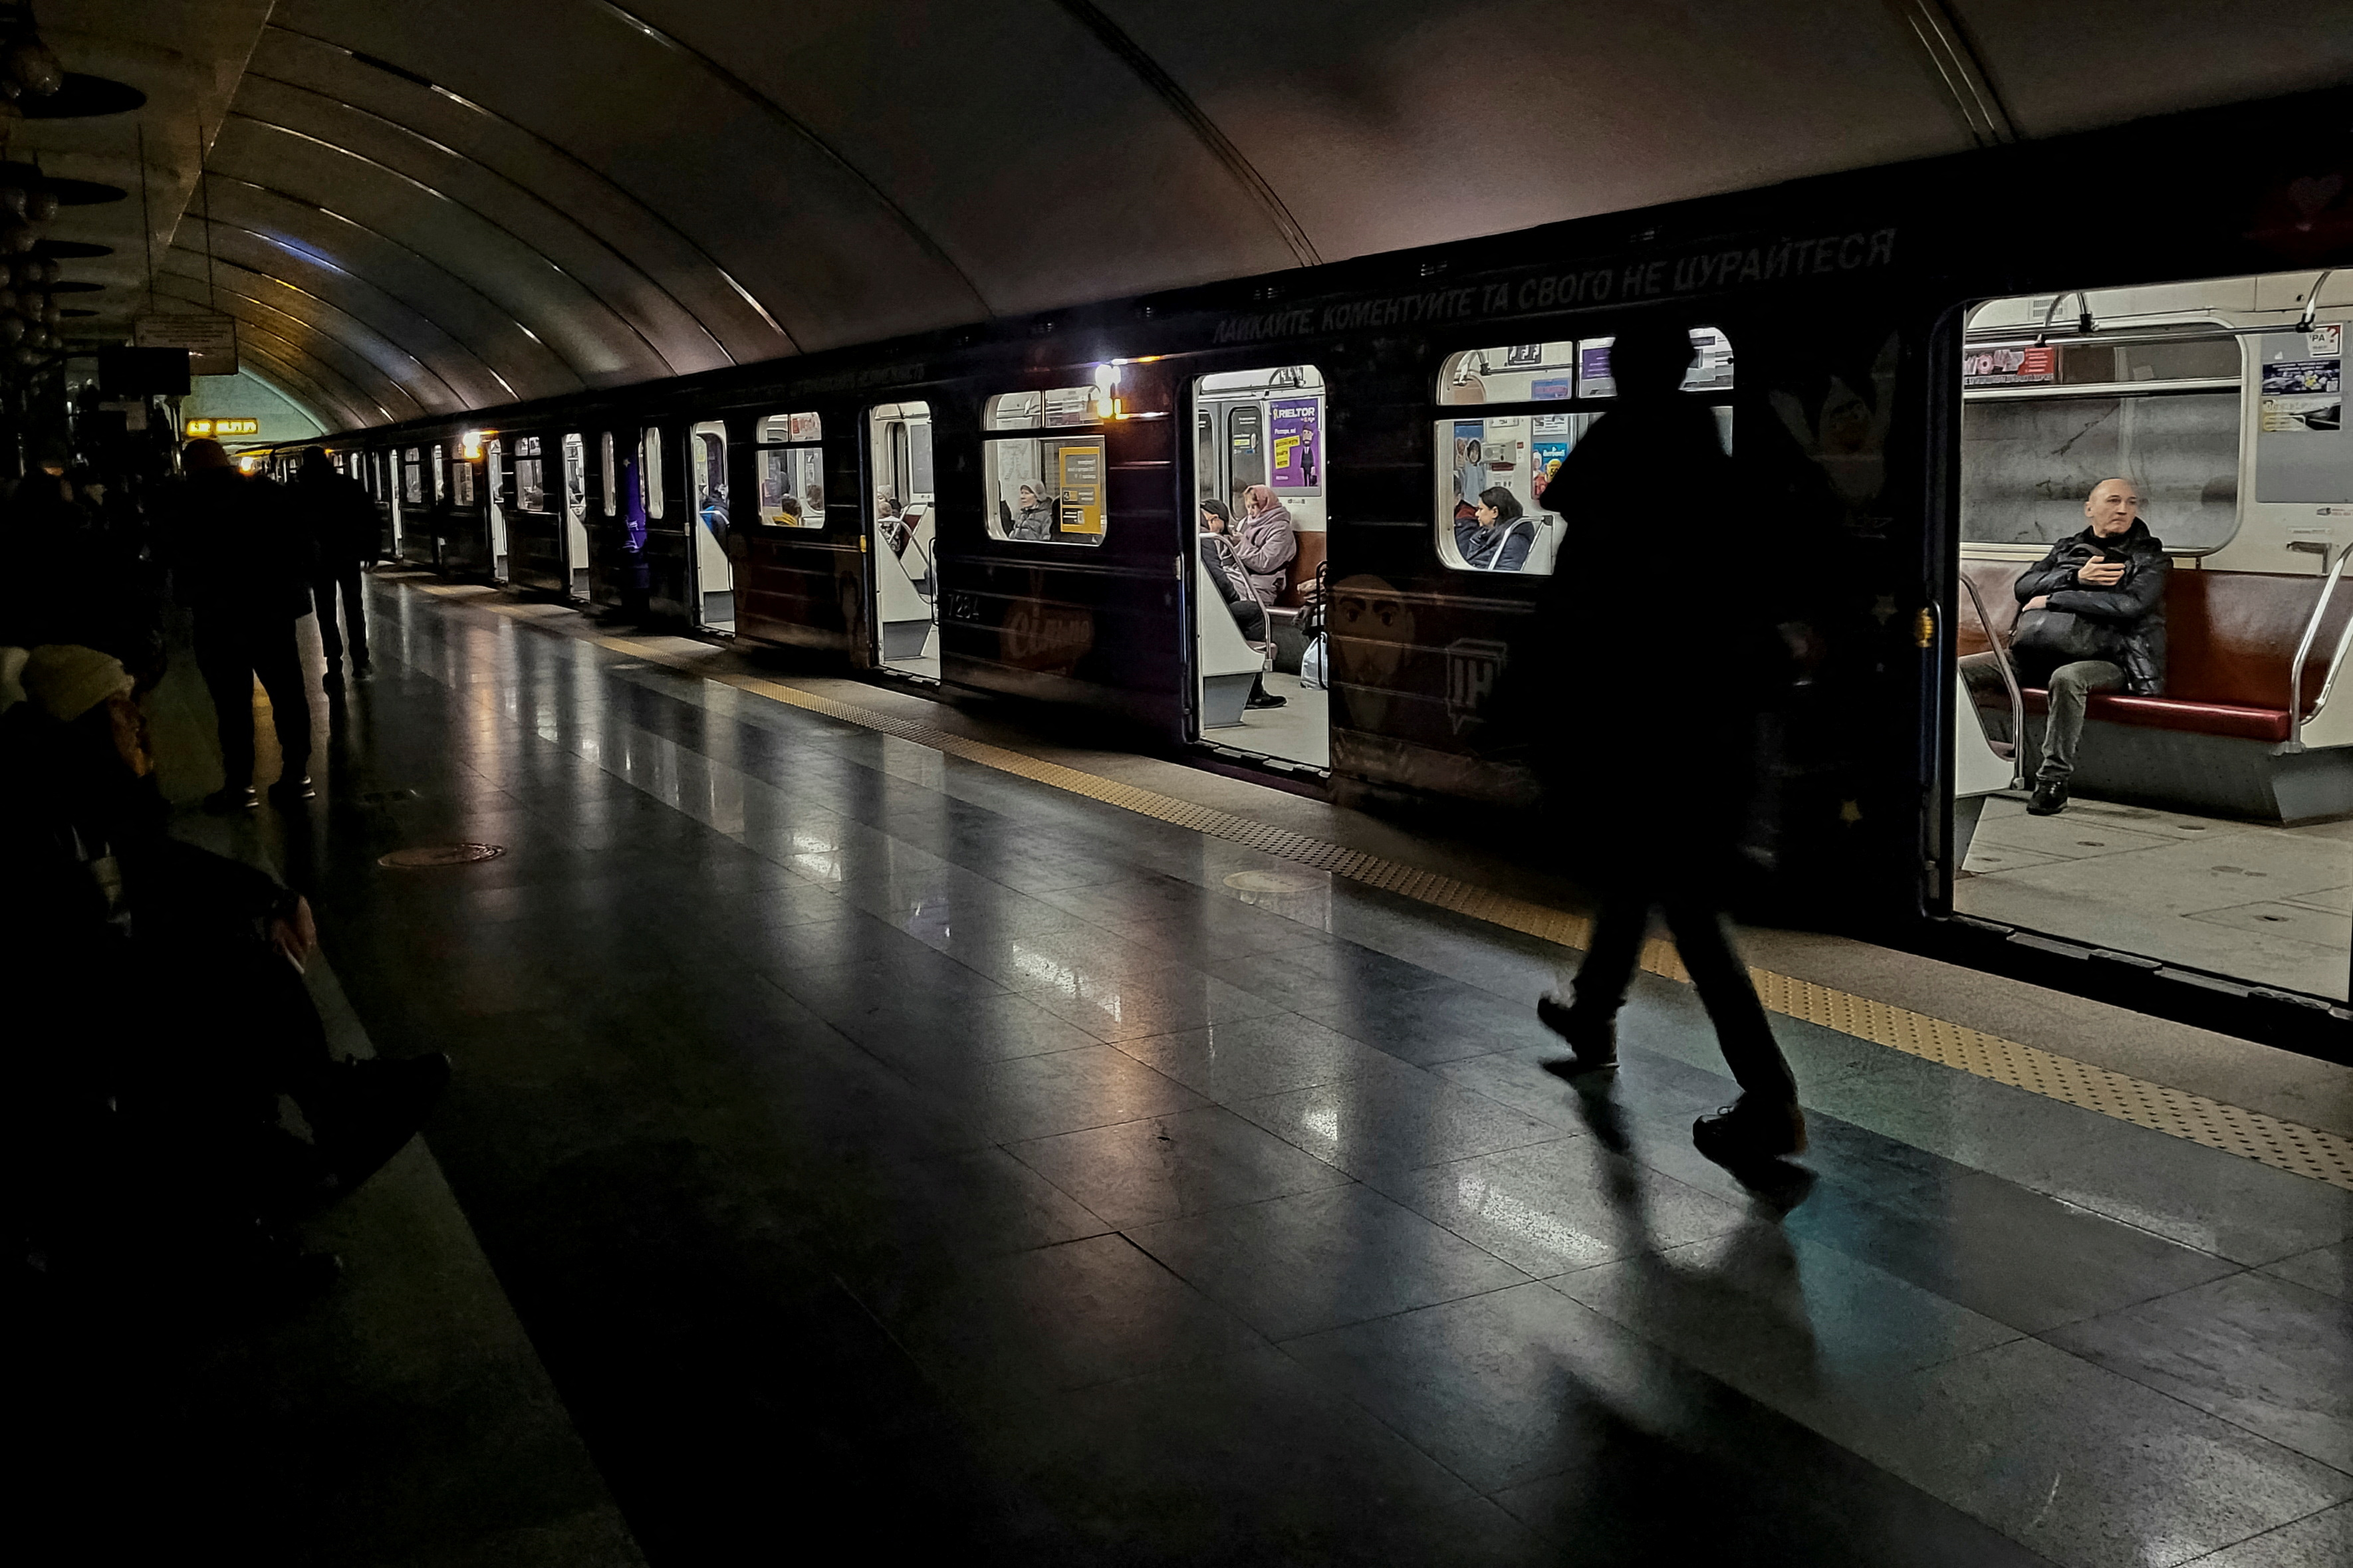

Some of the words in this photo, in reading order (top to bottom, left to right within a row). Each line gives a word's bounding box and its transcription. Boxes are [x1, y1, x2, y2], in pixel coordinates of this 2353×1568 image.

[1322, 287, 1476, 332] КОМЕНТУЙТЕ
[1482, 282, 1509, 313] ТА
[1519, 269, 1613, 310] СВОГО
[1622, 261, 1668, 299] НЕ
[1673, 227, 1898, 291] ЦУРАЙТЕСЯ
[1279, 407, 1315, 418] RIELTOR
